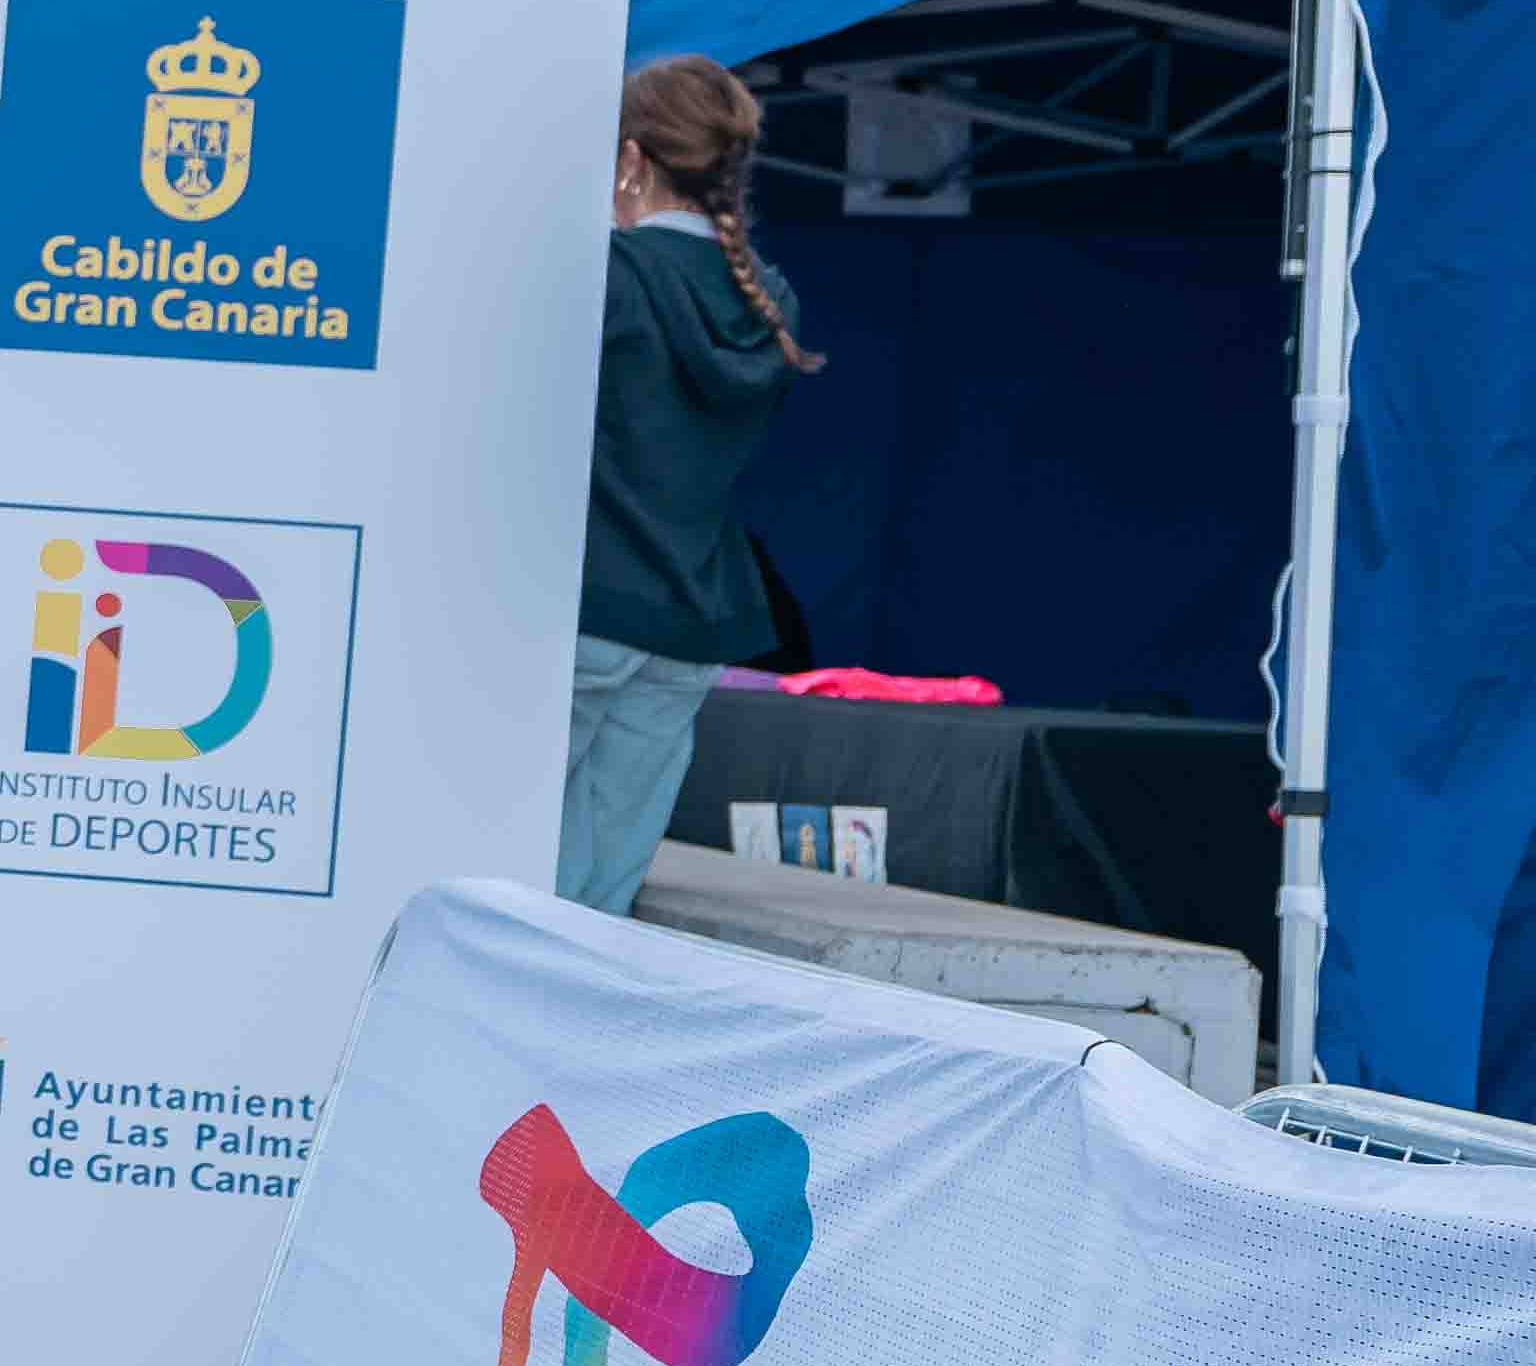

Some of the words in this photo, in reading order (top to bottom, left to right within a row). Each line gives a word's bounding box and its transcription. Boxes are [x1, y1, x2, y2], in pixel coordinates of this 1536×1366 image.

[40, 234, 240, 287] Cabildo
[253, 244, 318, 291] de
[14, 281, 137, 329] Gran
[150, 288, 349, 341] Canaria
[160, 772, 297, 817] INSULAR
[50, 812, 277, 865] DEPORTES
[32, 1110, 80, 1143] de
[106, 1115, 169, 1150] Las
[28, 1148, 74, 1180] de
[86, 1153, 176, 1189] Gran
